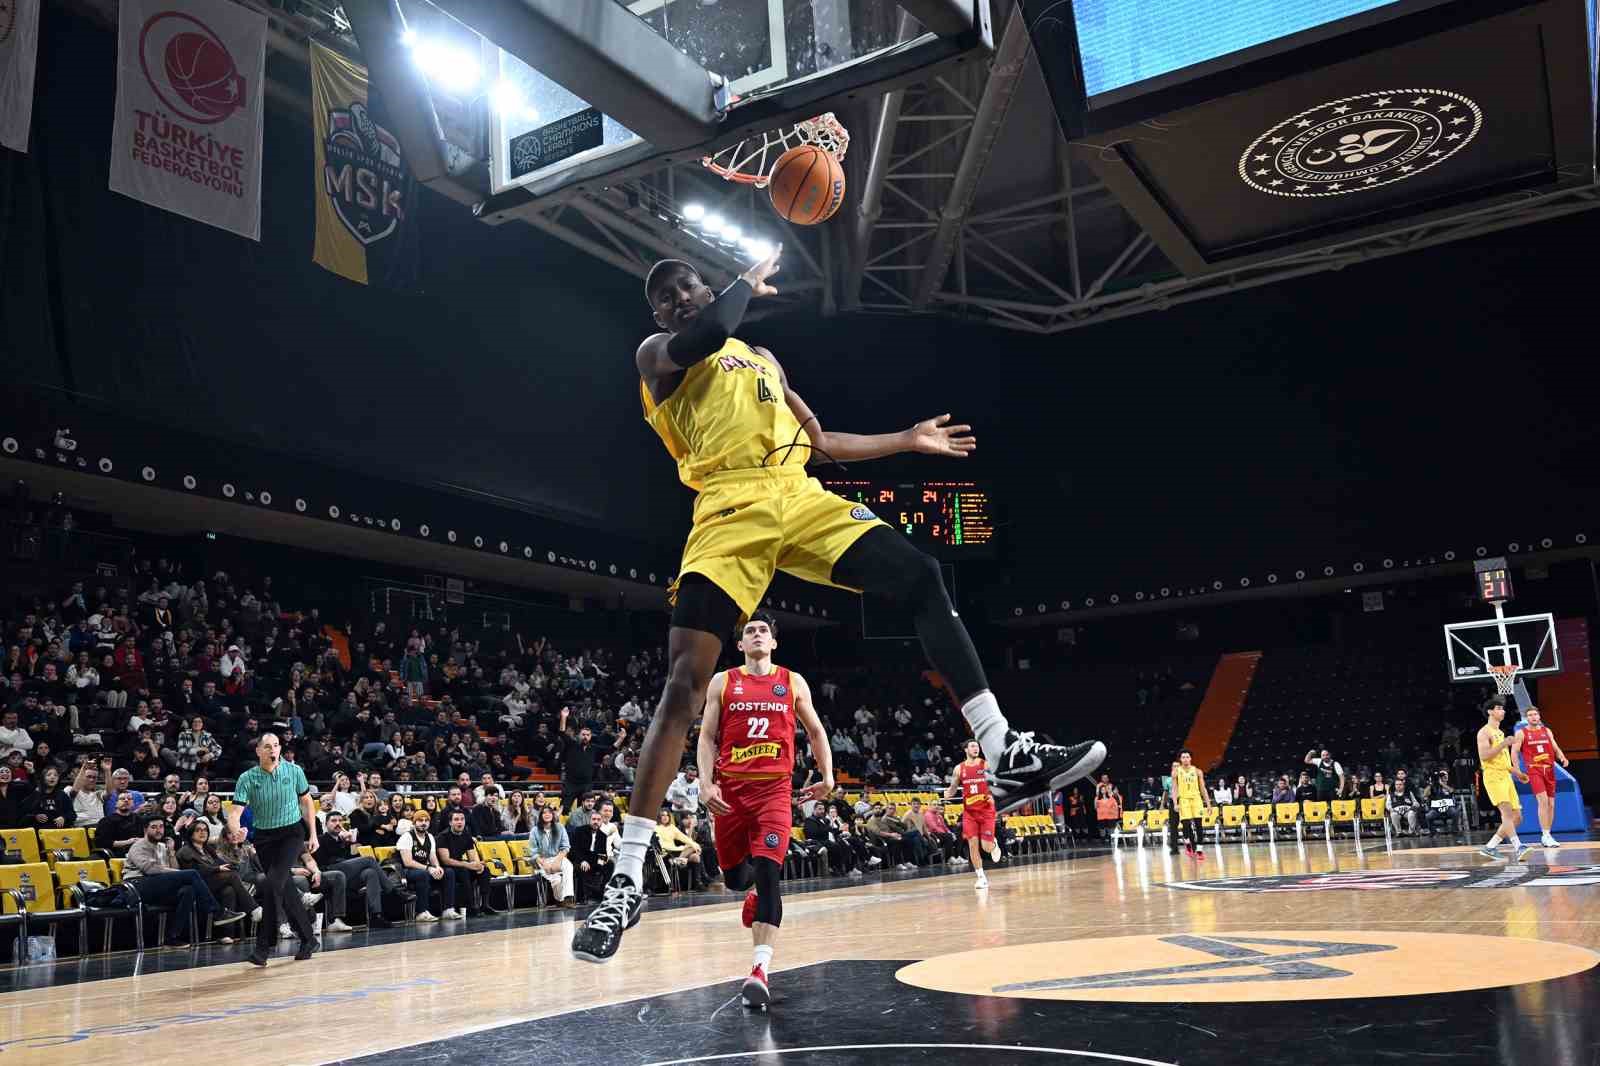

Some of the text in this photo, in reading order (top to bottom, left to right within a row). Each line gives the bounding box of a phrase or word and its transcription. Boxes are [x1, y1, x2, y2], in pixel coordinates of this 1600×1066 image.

[543, 116, 600, 144] CHAMPIONS
[1308, 119, 1348, 136] SPOR
[1352, 111, 1428, 124] BAKANLIĞI
[134, 109, 244, 168] TÜRKİYE
[134, 129, 242, 185] BASKETBOL
[132, 147, 243, 199] FEDERASYONU
[325, 163, 405, 221] MSK
[879, 490, 894, 502] 24
[922, 490, 937, 502] 24
[900, 512, 924, 524] 6 17
[905, 524, 912, 534] 2
[932, 525, 940, 536] 2
[1484, 582, 1505, 598] 21
[729, 701, 789, 713] OOSTENDE
[747, 717, 769, 739] 22
